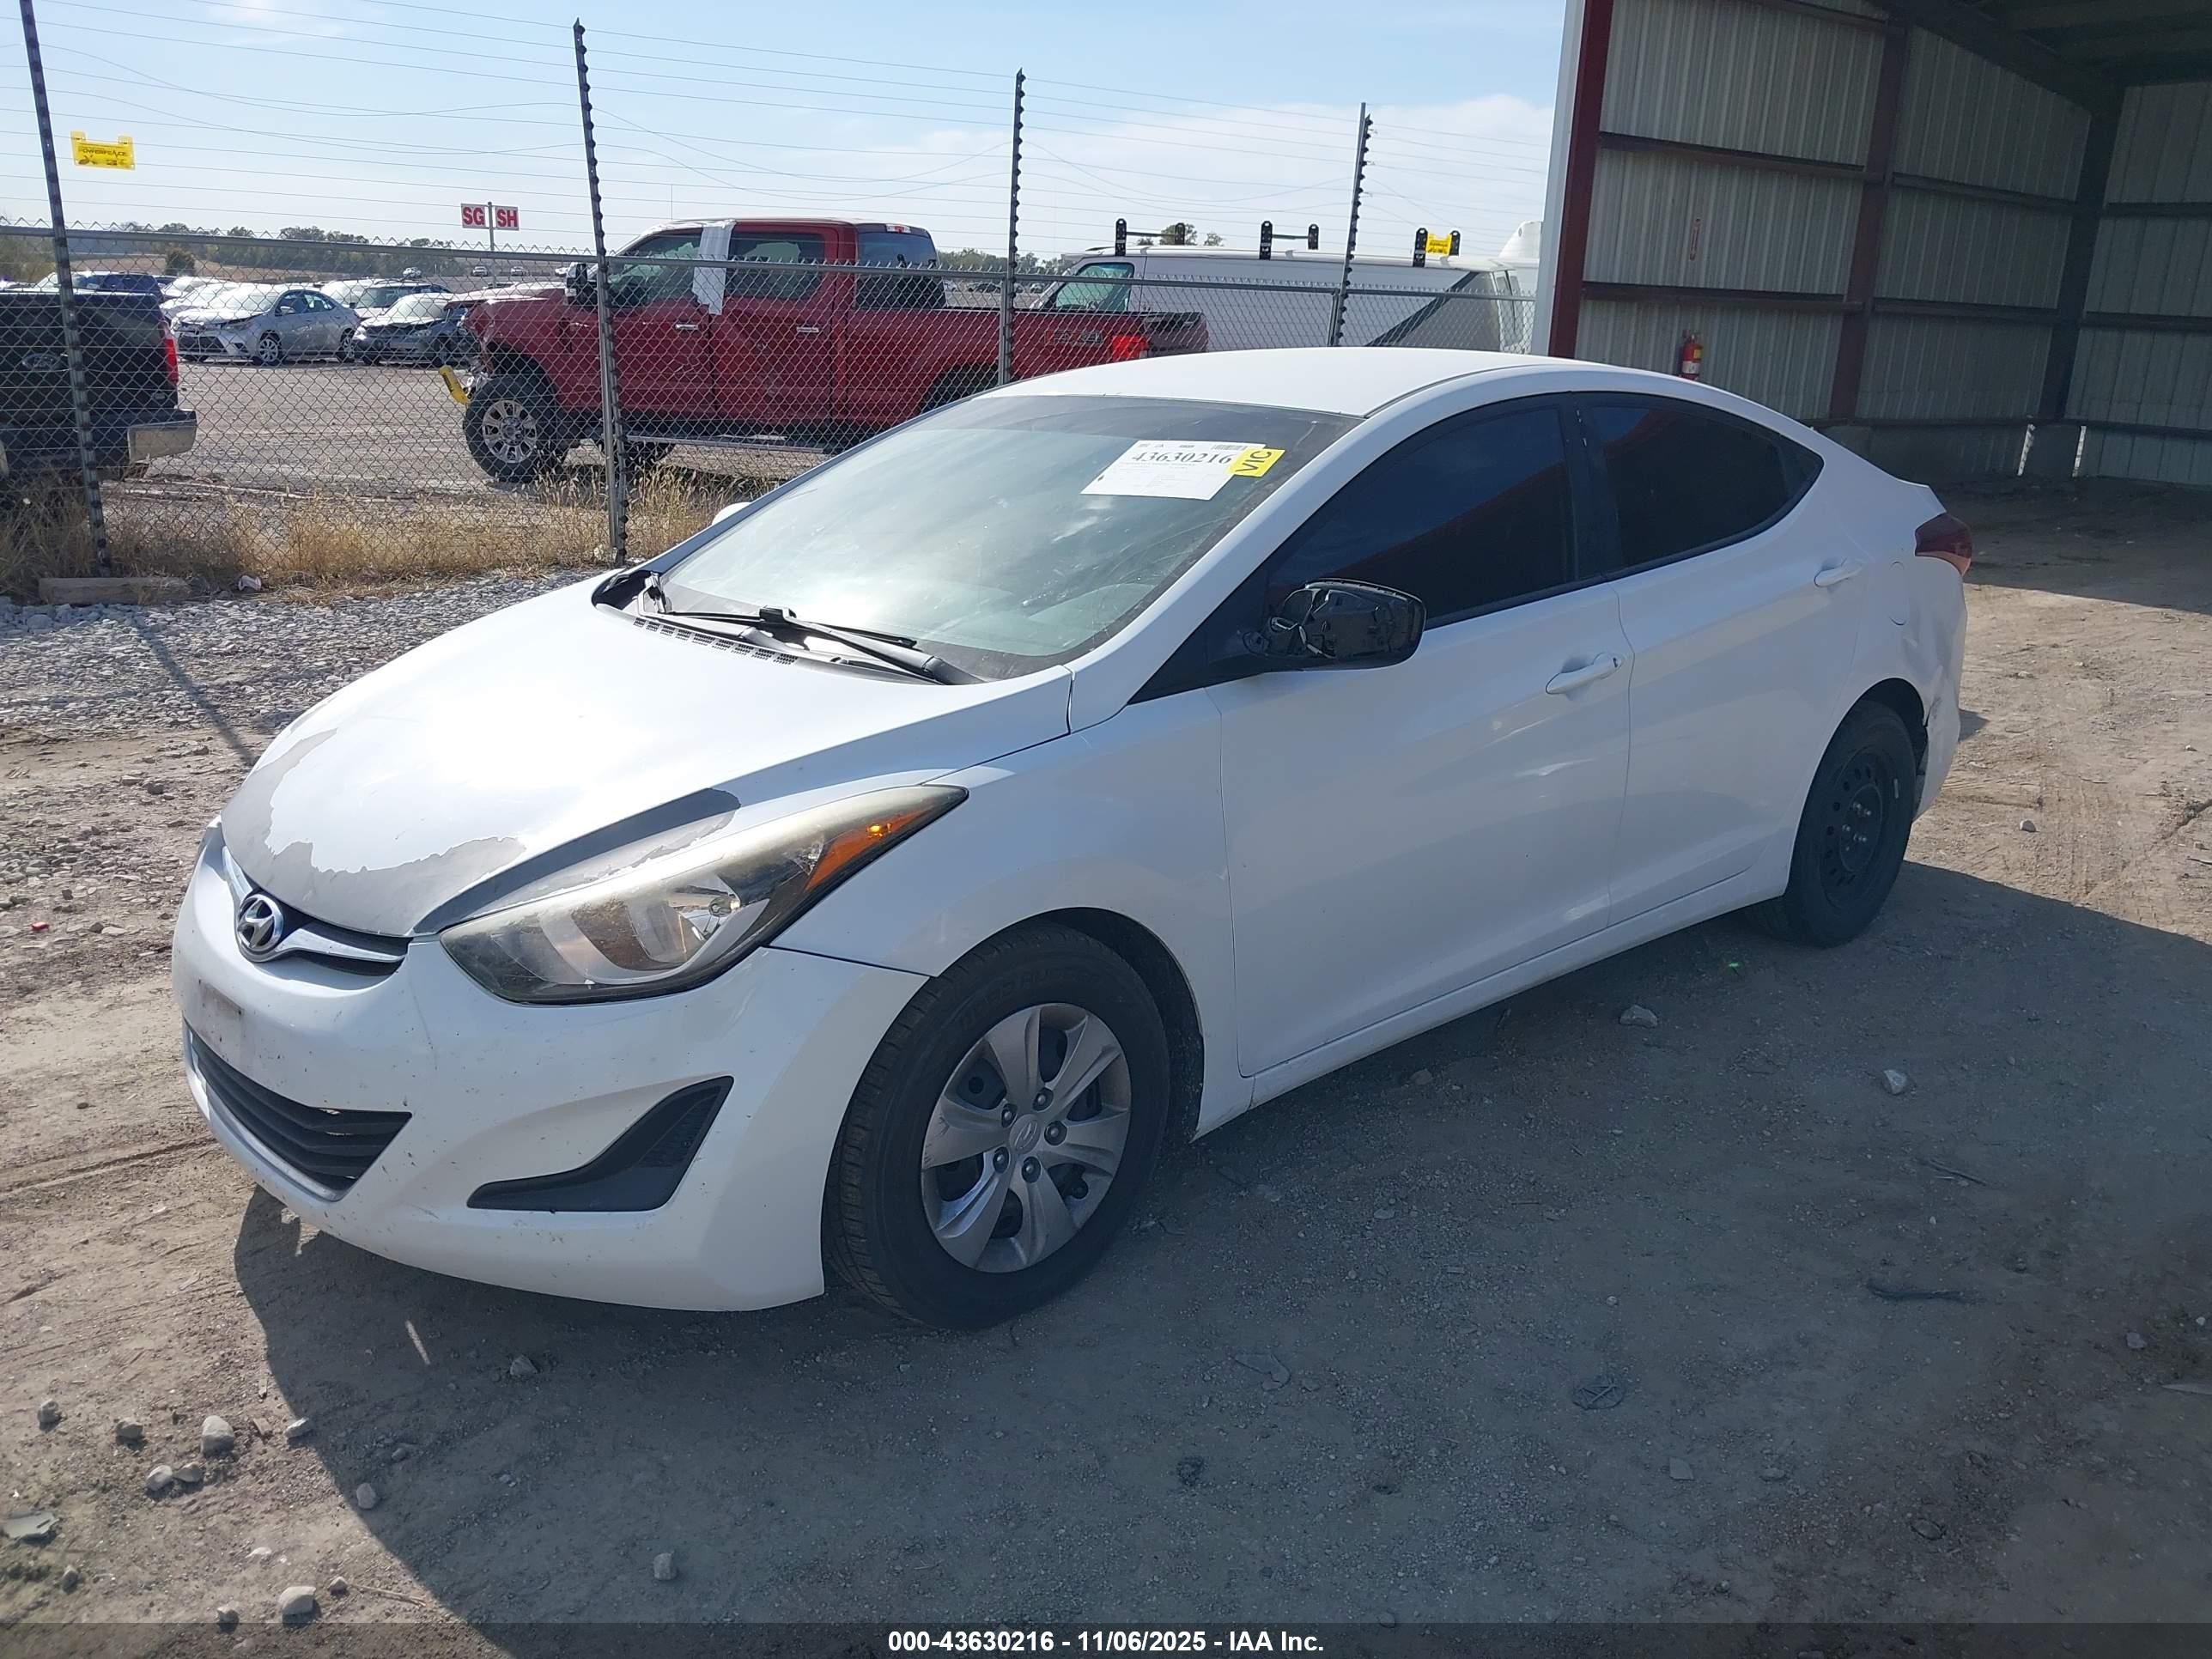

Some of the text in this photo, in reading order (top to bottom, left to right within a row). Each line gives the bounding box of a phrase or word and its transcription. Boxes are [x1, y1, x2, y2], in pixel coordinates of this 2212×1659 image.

[462, 206, 485, 226] SG
[496, 209, 518, 228] SH
[1132, 452, 1237, 465] 43630216
[1235, 450, 1273, 472] VIC
